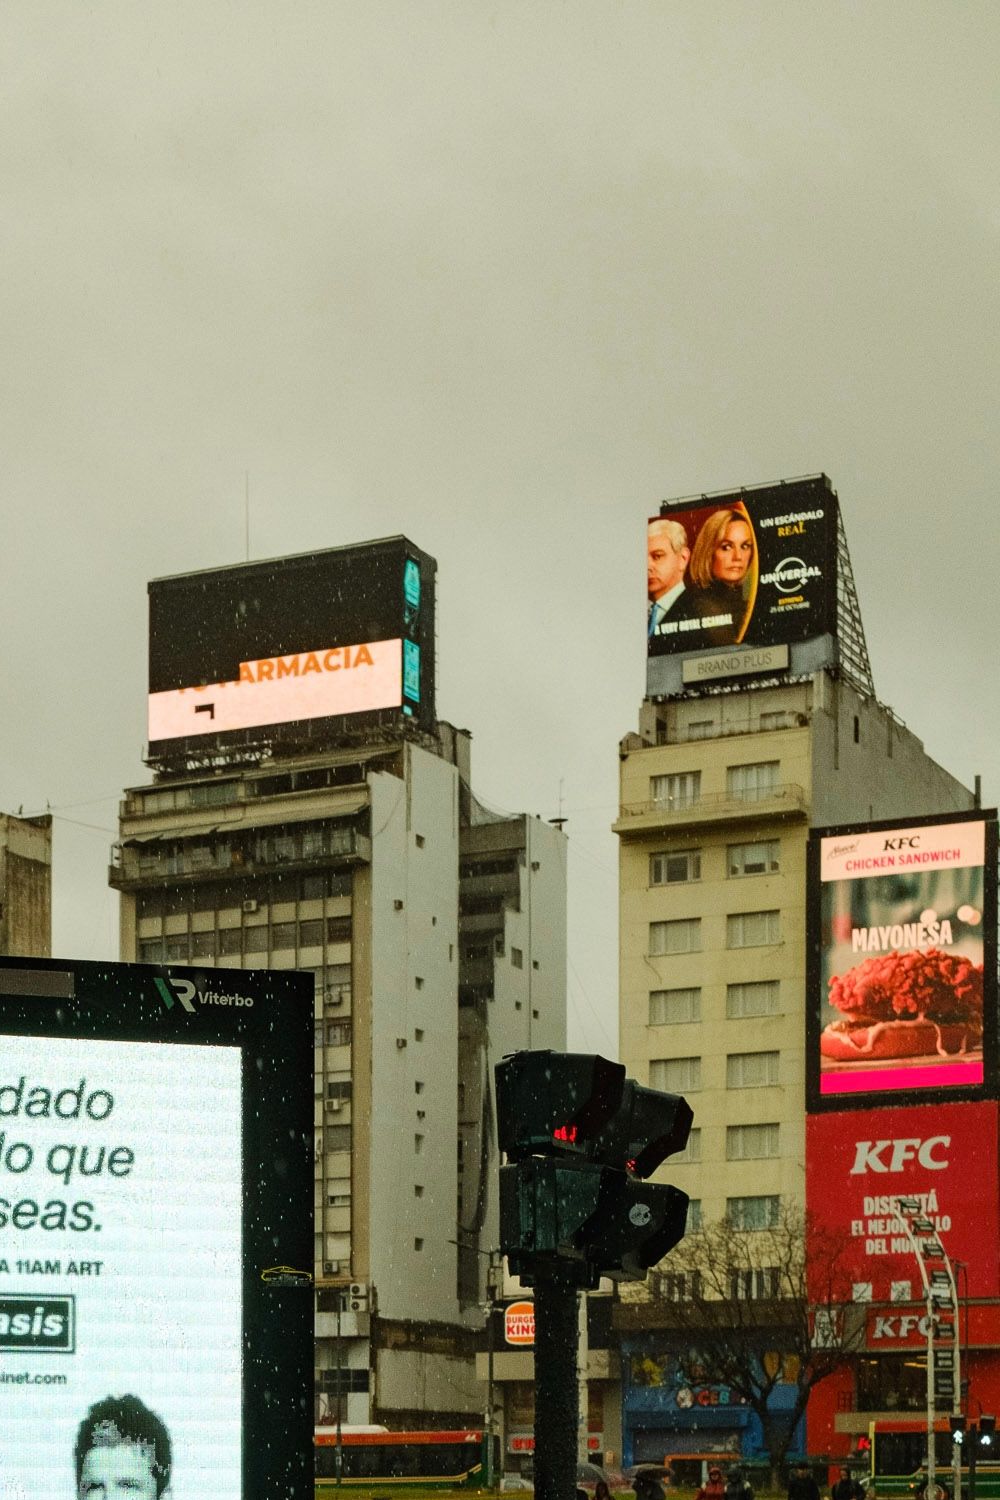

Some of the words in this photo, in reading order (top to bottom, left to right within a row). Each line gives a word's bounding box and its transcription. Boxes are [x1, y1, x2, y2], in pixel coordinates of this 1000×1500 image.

[760, 518, 774, 528] UN
[778, 521, 806, 537] REAL
[697, 657, 741, 675] BRAND
[743, 652, 772, 668] PLUS
[883, 836, 921, 851] KFC
[846, 856, 895, 872] CHICKEN
[899, 849, 961, 866] SANDWICH
[851, 920, 954, 953] MAYONESA
[198, 991, 254, 1008] Viterbo
[850, 1135, 951, 1175] KFC
[46, 1144, 135, 1185] que
[851, 1220, 865, 1237] EL
[865, 1238, 889, 1256] DEL
[16, 1260, 61, 1275] 11AM
[66, 1261, 104, 1276] ART
[506, 1316, 535, 1324] BURGE
[873, 1315, 940, 1339] KFC
